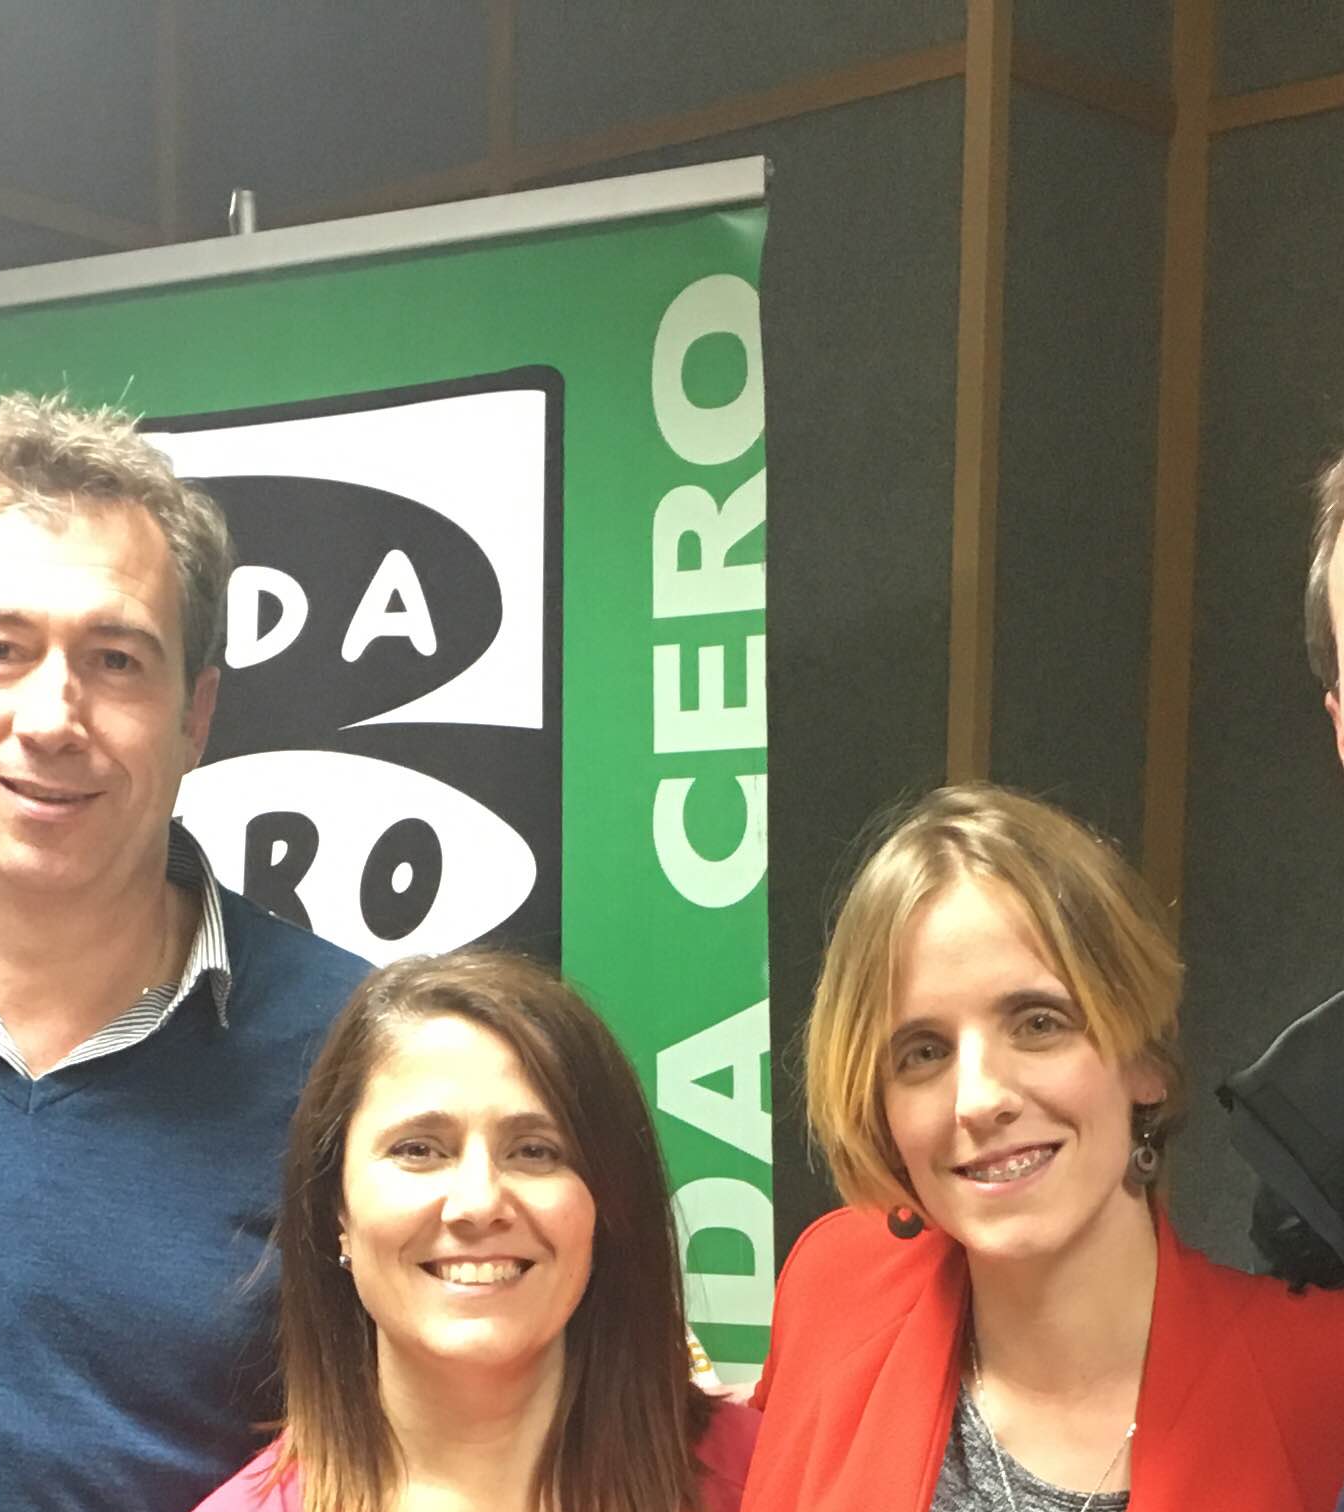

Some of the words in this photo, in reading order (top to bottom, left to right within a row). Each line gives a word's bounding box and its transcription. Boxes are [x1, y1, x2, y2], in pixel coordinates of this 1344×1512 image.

[224, 548, 437, 670] DA
[652, 273, 768, 909] CERO
[243, 810, 443, 941] RO
[656, 997, 775, 1386] DA
